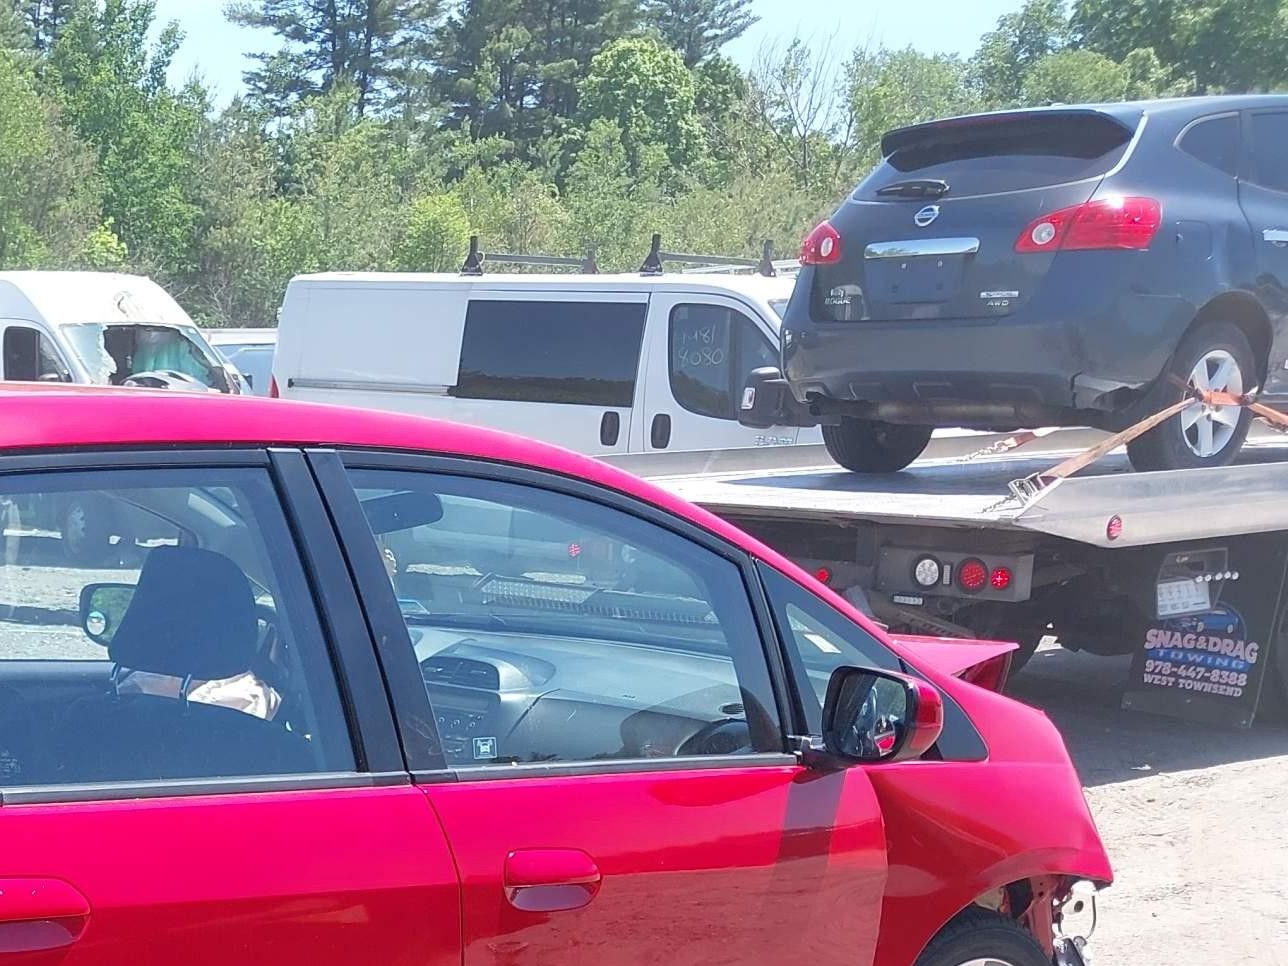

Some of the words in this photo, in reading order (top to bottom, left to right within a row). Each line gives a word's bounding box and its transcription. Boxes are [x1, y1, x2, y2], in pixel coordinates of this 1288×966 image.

[1157, 648, 1246, 670] TOWING
[1143, 673, 1175, 687] WEST
[1178, 678, 1243, 697] TOWNSEND
[1145, 659, 1248, 687] 978-447-8388
